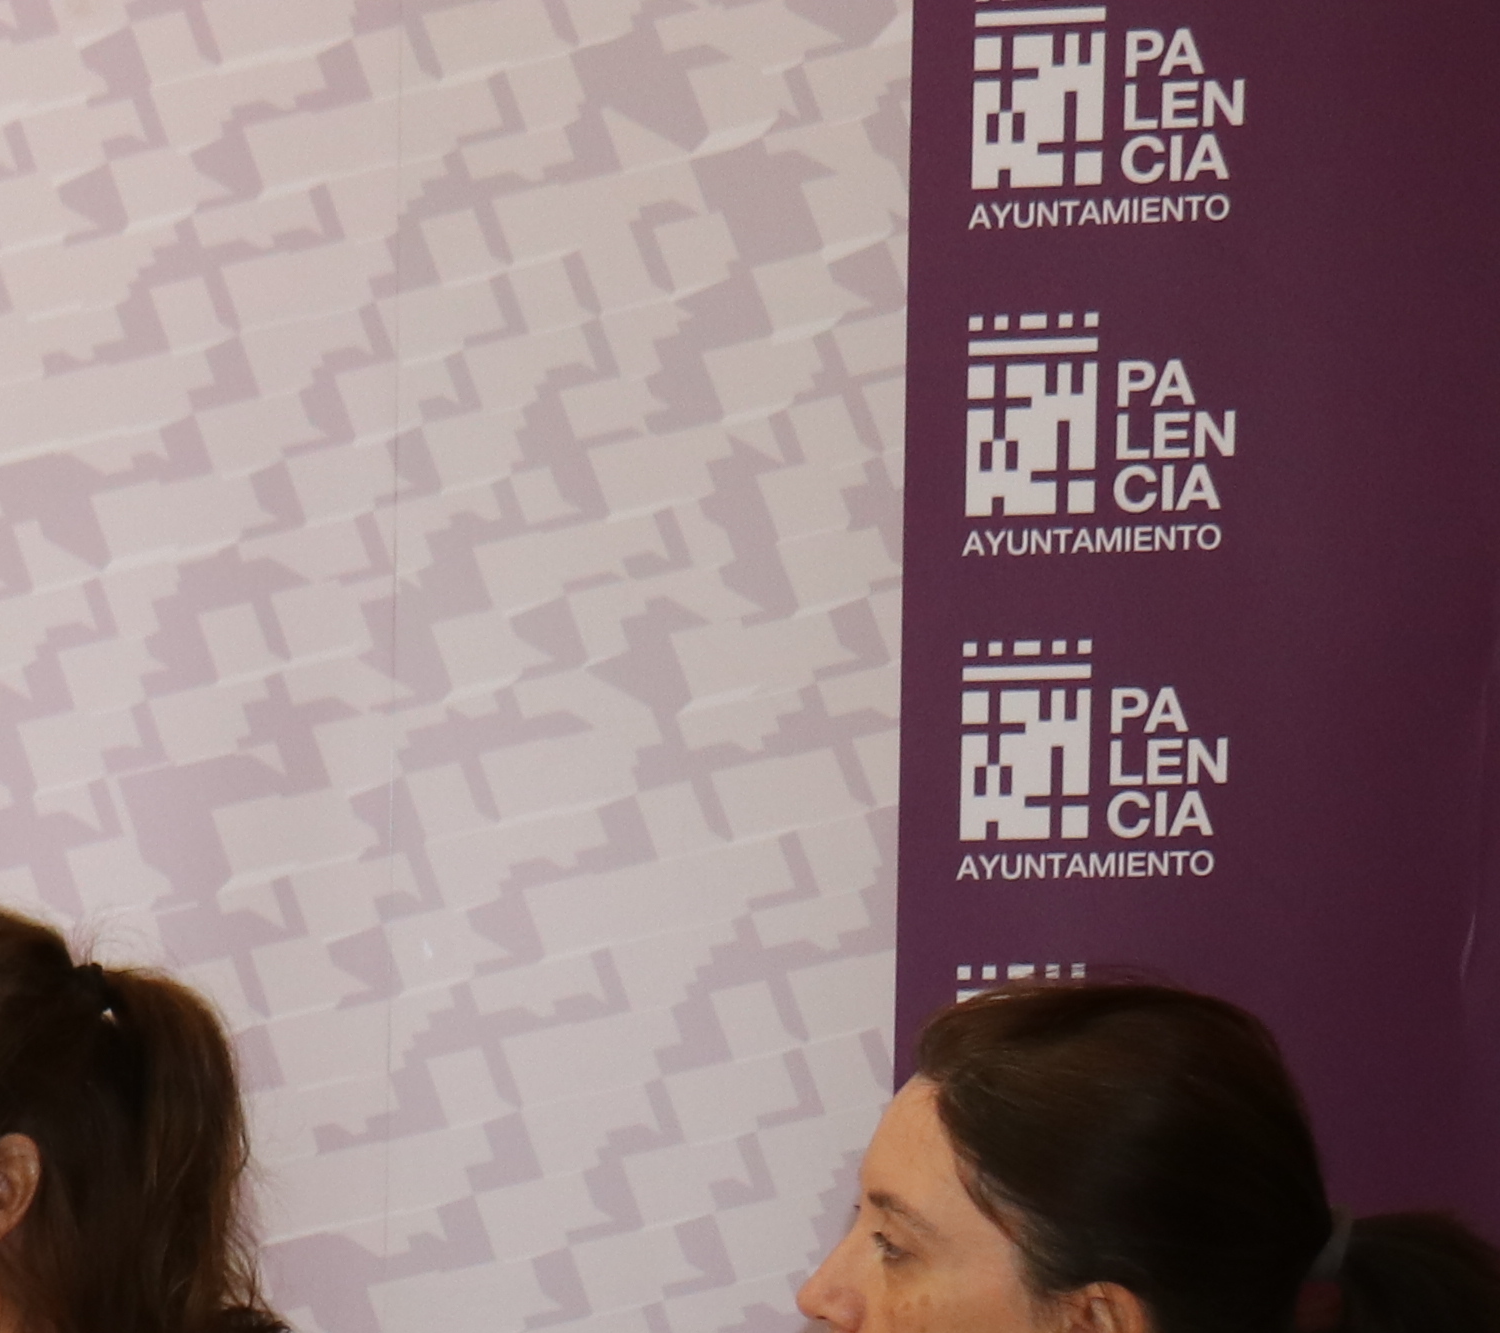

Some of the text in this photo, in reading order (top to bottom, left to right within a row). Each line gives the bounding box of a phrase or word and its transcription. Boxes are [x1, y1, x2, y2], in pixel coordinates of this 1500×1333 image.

[1125, 28, 1205, 78] PA
[1124, 79, 1246, 131] LEN
[1121, 134, 1229, 183] CIA
[968, 194, 1230, 230] AYUNTAMIENTO
[1117, 358, 1197, 408] PA
[1115, 410, 1238, 461] LEN
[1112, 464, 1221, 513] CIA
[961, 522, 1223, 557] AYUNTAMIENTO
[1109, 686, 1190, 733] PA
[1108, 736, 1229, 786] LEN
[1106, 788, 1214, 837] CIA
[955, 848, 1216, 881] AYUNTAMIENTO
